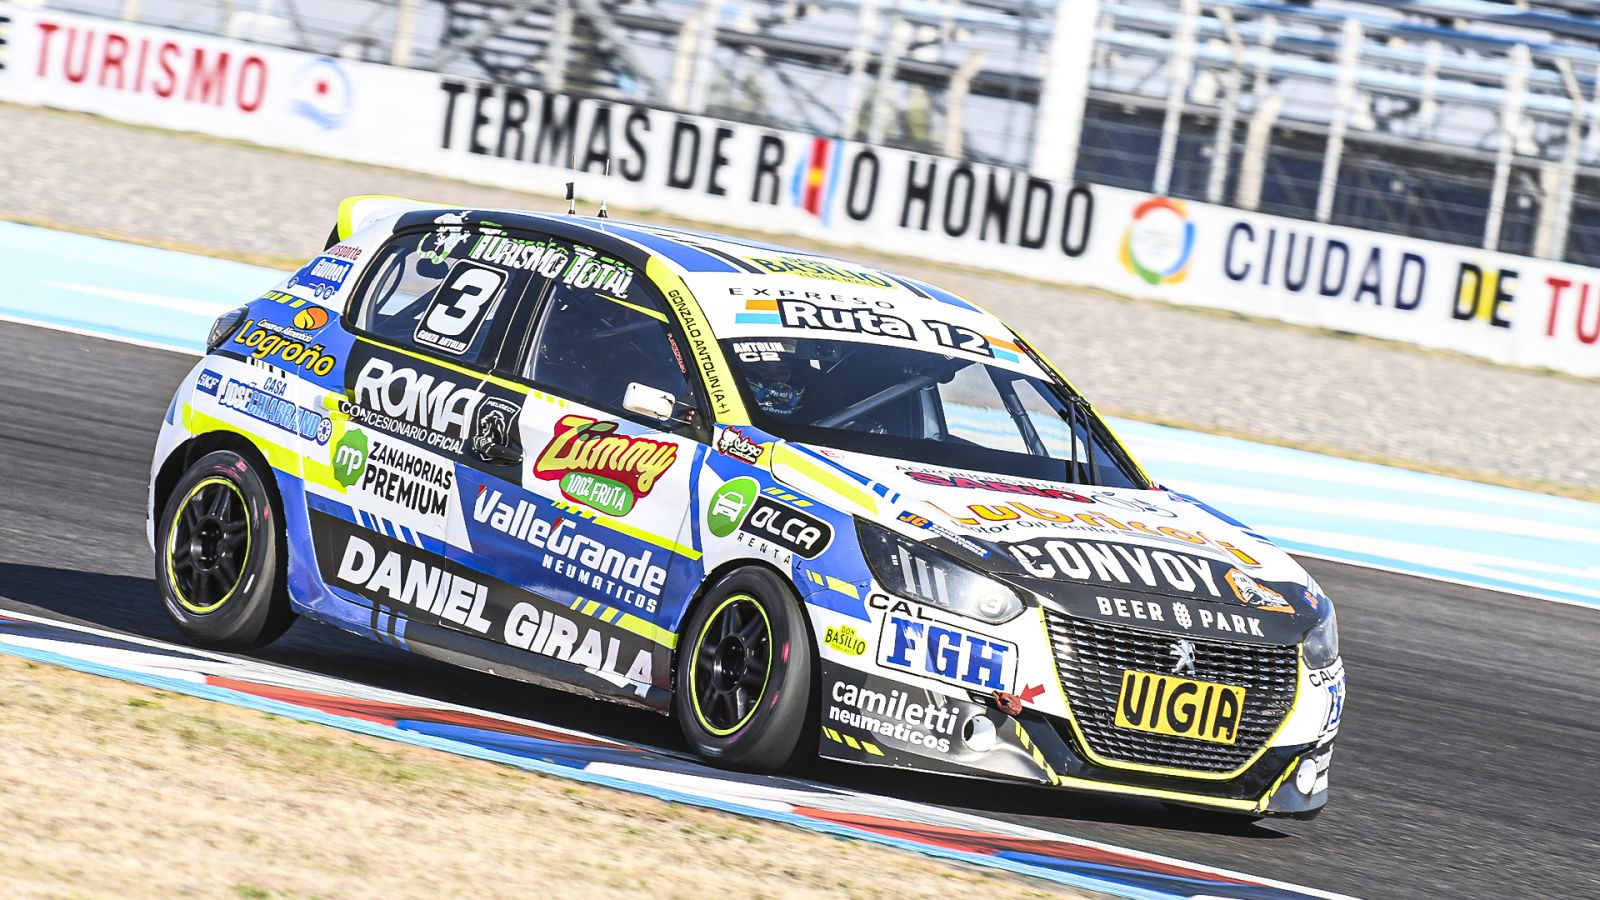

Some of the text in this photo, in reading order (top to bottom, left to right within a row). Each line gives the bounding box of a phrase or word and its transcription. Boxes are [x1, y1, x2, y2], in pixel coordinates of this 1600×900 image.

[36, 23, 268, 112] TURISMO
[438, 80, 650, 184] TERMAS
[668, 118, 735, 196] DE
[898, 159, 1095, 257] HONDO
[469, 224, 634, 299] TURISMO TOTAL
[751, 257, 893, 288] BASILIO
[1223, 222, 1427, 311] CIUDAD
[1452, 262, 1519, 329] DE
[426, 268, 501, 335] 3
[728, 287, 895, 310] EXPRESO
[234, 319, 337, 377] Logroño
[667, 289, 702, 338] GONZALO
[694, 338, 721, 390] ANTOLIN
[732, 341, 785, 353] ANTOLIN
[778, 300, 994, 357] Ruta 12
[739, 351, 781, 363] C2
[199, 373, 220, 390] SKF
[263, 376, 288, 396] CASA
[354, 357, 486, 440] ROMA
[341, 402, 464, 455] CONCESIONARIO OFICIAL
[486, 400, 516, 414] PEUGEOT
[335, 445, 363, 476] mp
[368, 441, 453, 490] ZANAHORIAS
[362, 464, 449, 517] PREMIUM
[565, 474, 627, 511] 100% FRUTA
[750, 506, 822, 550] OLCA
[1017, 519, 1047, 529] Oil
[737, 532, 802, 571] RENTAL
[1008, 539, 1222, 598] CONVOY
[541, 554, 658, 614] NEUMATICOS
[869, 593, 934, 622] CAL
[337, 534, 653, 698] DANIEL GIRALA
[1096, 596, 1265, 638] BEER PARK
[825, 628, 866, 656] BASILIO
[887, 616, 1009, 691] FGH
[1309, 669, 1335, 687] CAL
[829, 705, 951, 753] neumaticos
[832, 681, 960, 736] camiletti
